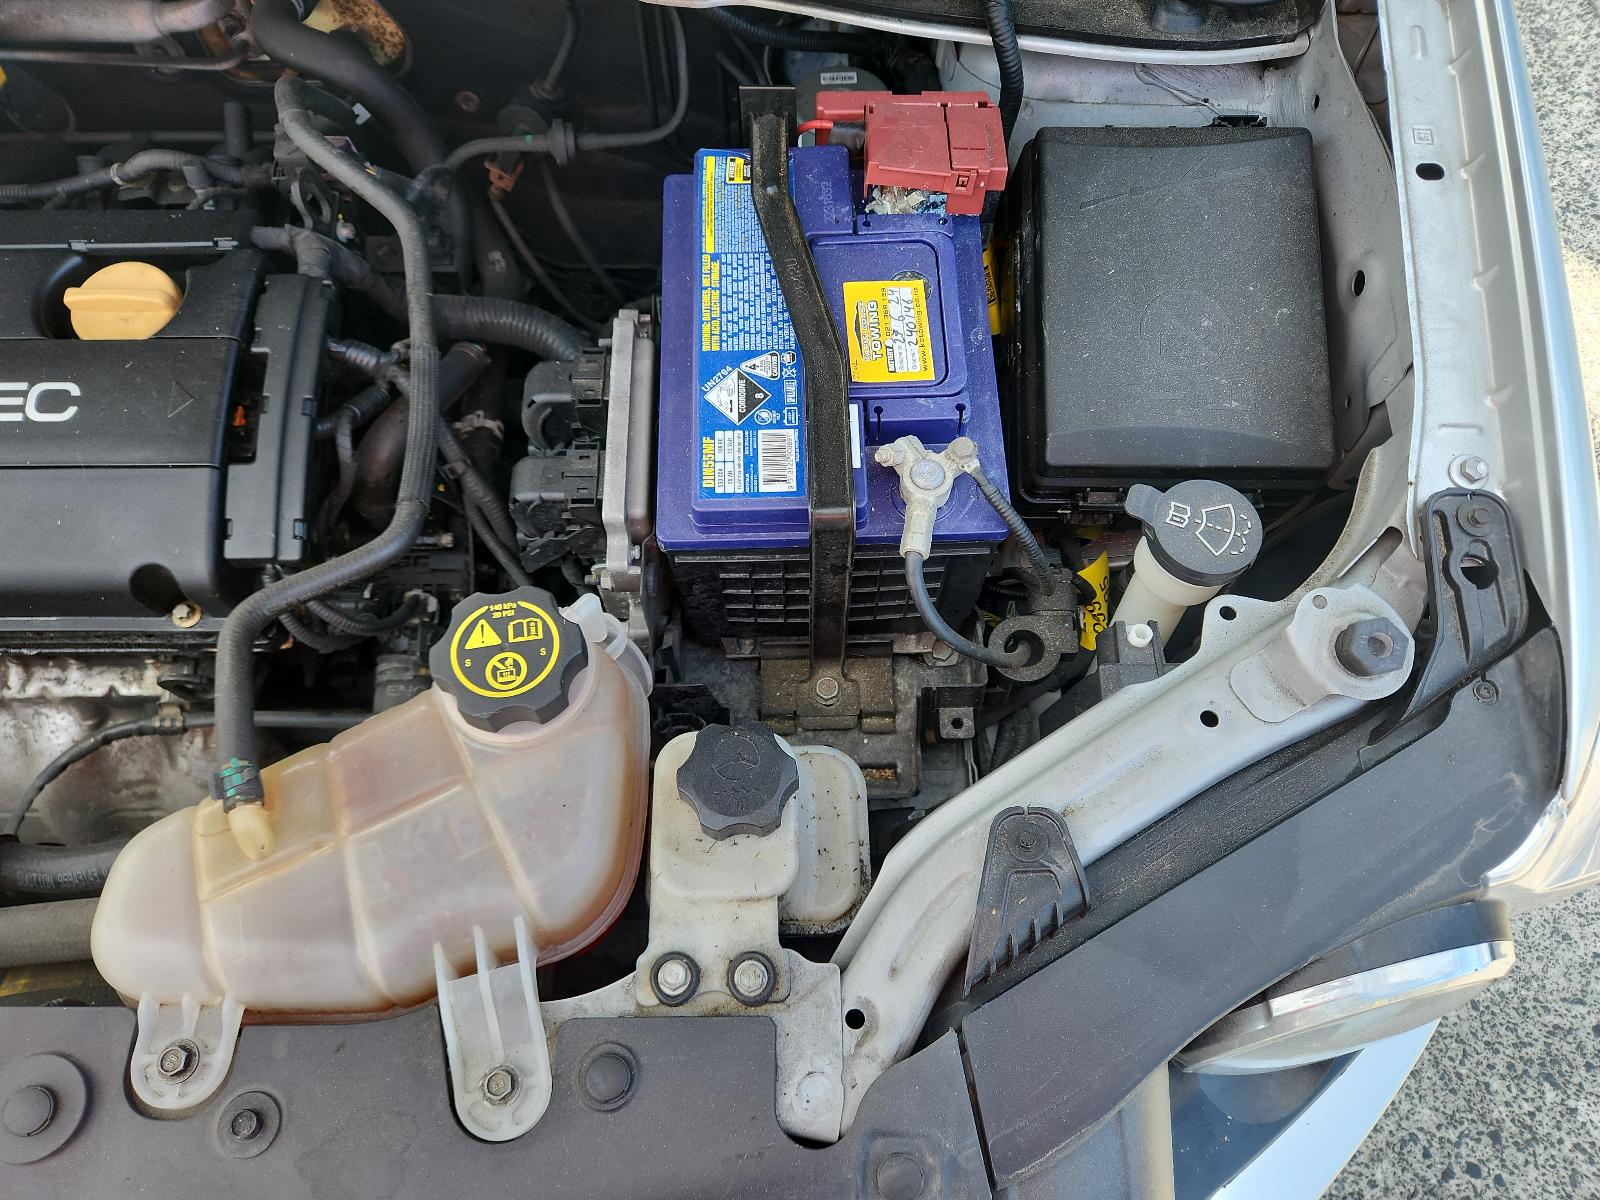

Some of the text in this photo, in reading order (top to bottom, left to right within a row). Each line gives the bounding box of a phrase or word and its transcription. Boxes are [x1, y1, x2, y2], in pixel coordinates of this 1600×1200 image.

[702, 254, 711, 273] FILLED
[702, 274, 711, 286] WET
[702, 288, 711, 320] BATTERIES,
[711, 290, 720, 317] ELECTRIC
[888, 289, 899, 304] 24
[868, 300, 882, 360] TOWING
[902, 298, 918, 347] 240146
[711, 336, 720, 351] WITH
[701, 366, 733, 392] UN2794
[738, 379, 746, 413] CORROSIVE
[702, 436, 714, 488] DIN55MF
[489, 602, 516, 612] 140 kPa
[464, 659, 472, 667] S
[540, 648, 546, 656] S
